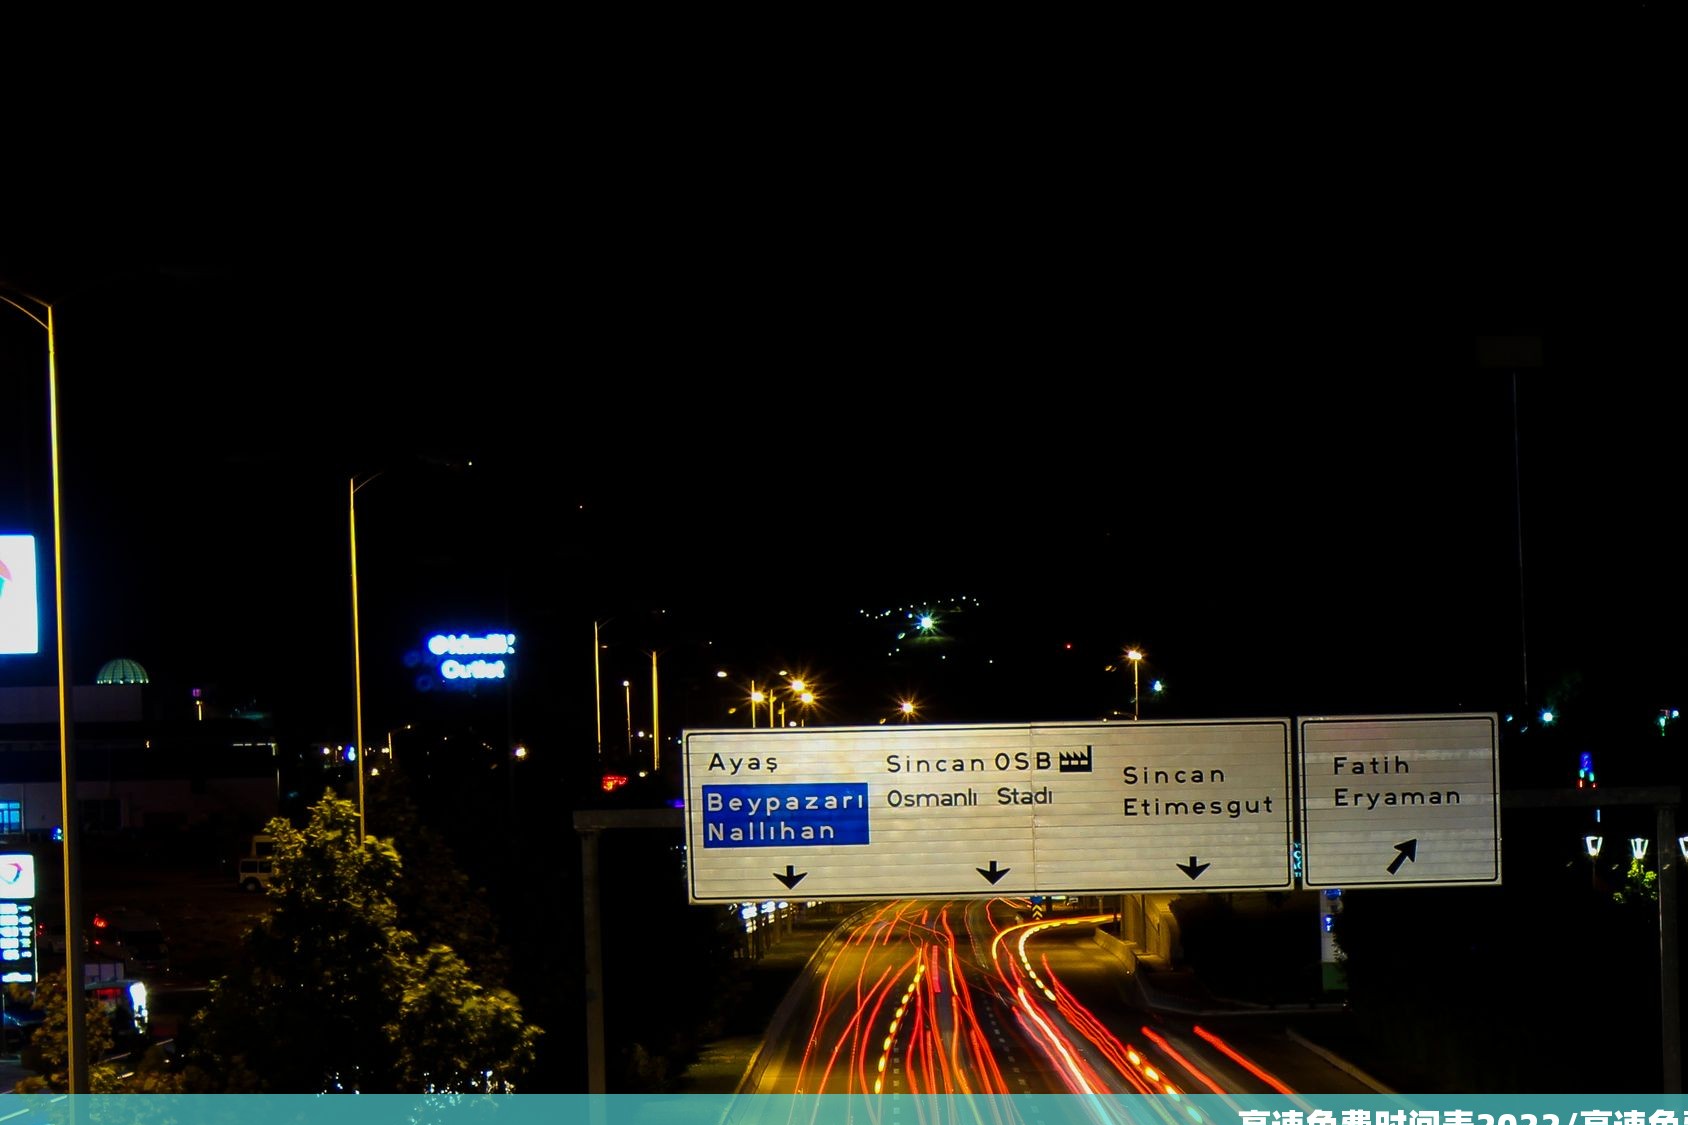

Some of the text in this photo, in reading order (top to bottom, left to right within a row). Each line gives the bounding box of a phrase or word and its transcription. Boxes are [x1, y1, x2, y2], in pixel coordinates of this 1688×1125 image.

[708, 752, 778, 776] Ayaş
[886, 751, 1052, 774] Sincan OSB
[1333, 756, 1410, 776] Fatih
[1123, 766, 1225, 785] Sincan
[706, 791, 865, 817] Beypazarı
[886, 786, 1053, 808] Osmanlı Stadı
[1123, 795, 1274, 819] Etimesgut
[1334, 788, 1461, 811] Eryaman
[707, 821, 836, 842] Nallıhan
